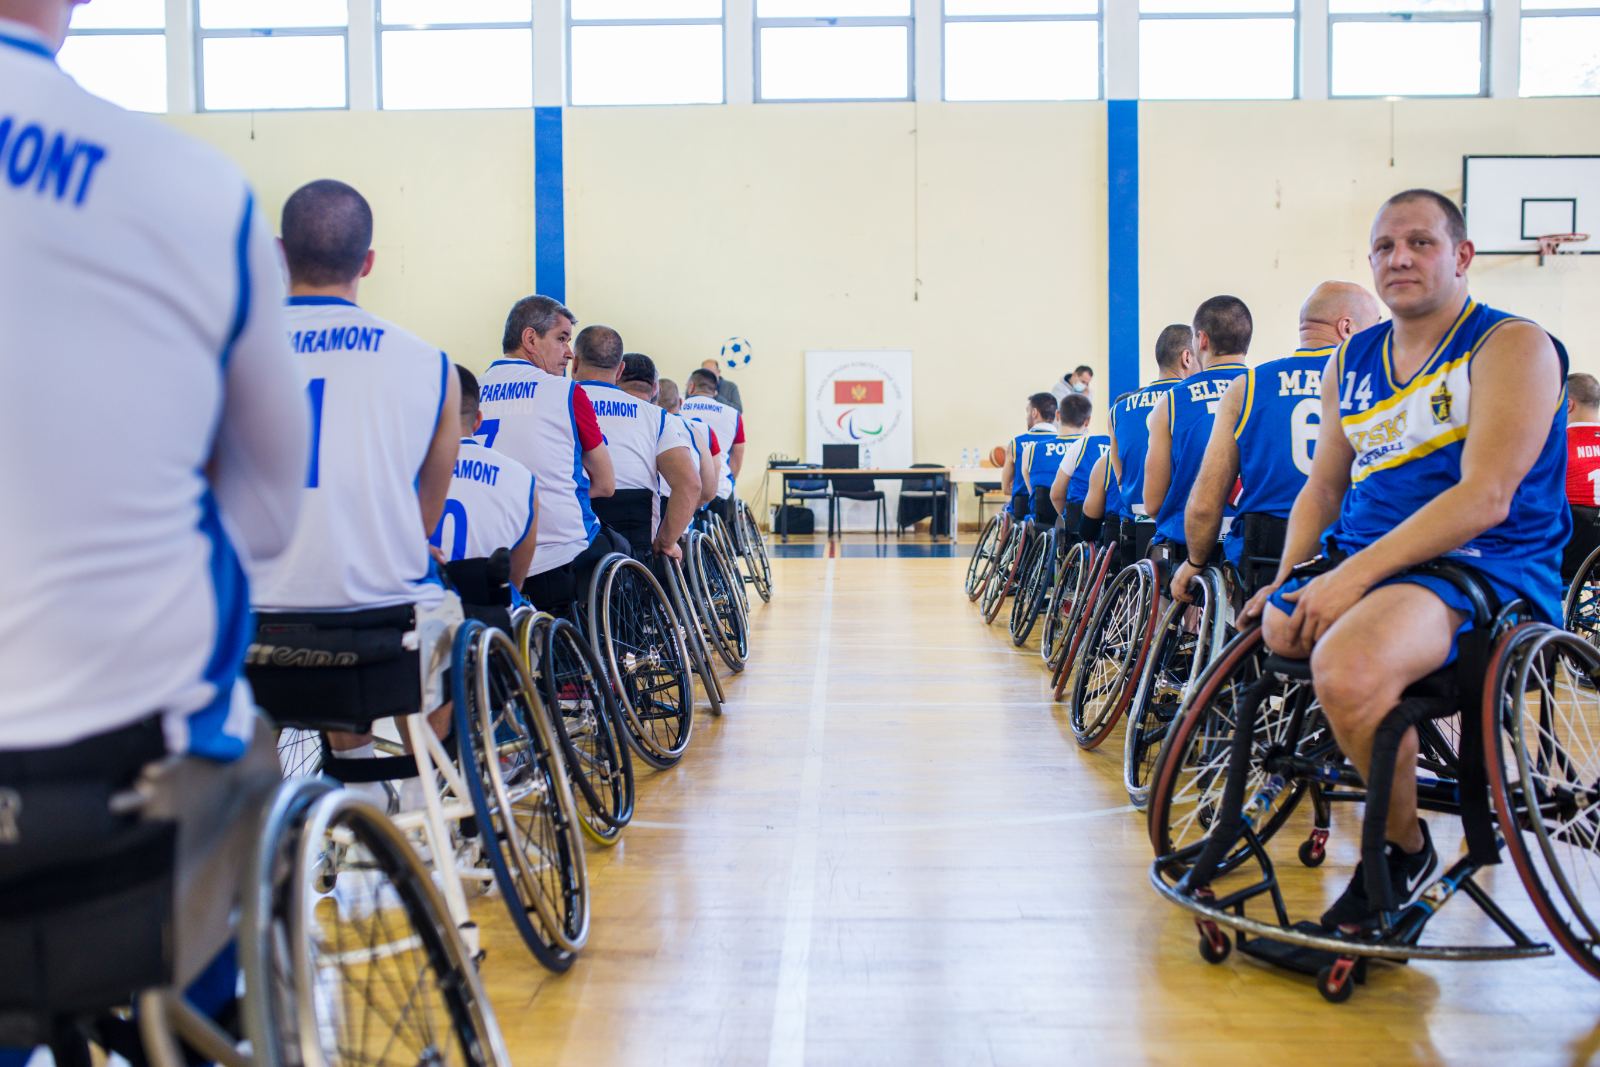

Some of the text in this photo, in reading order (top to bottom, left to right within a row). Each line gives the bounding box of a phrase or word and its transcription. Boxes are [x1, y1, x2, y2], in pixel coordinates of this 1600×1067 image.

[289, 327, 385, 353] ARAMONT
[480, 382, 539, 402] PARAMONT
[1340, 371, 1373, 411] 14
[591, 400, 637, 418] ARAMONT
[693, 403, 722, 413] PARAMONT
